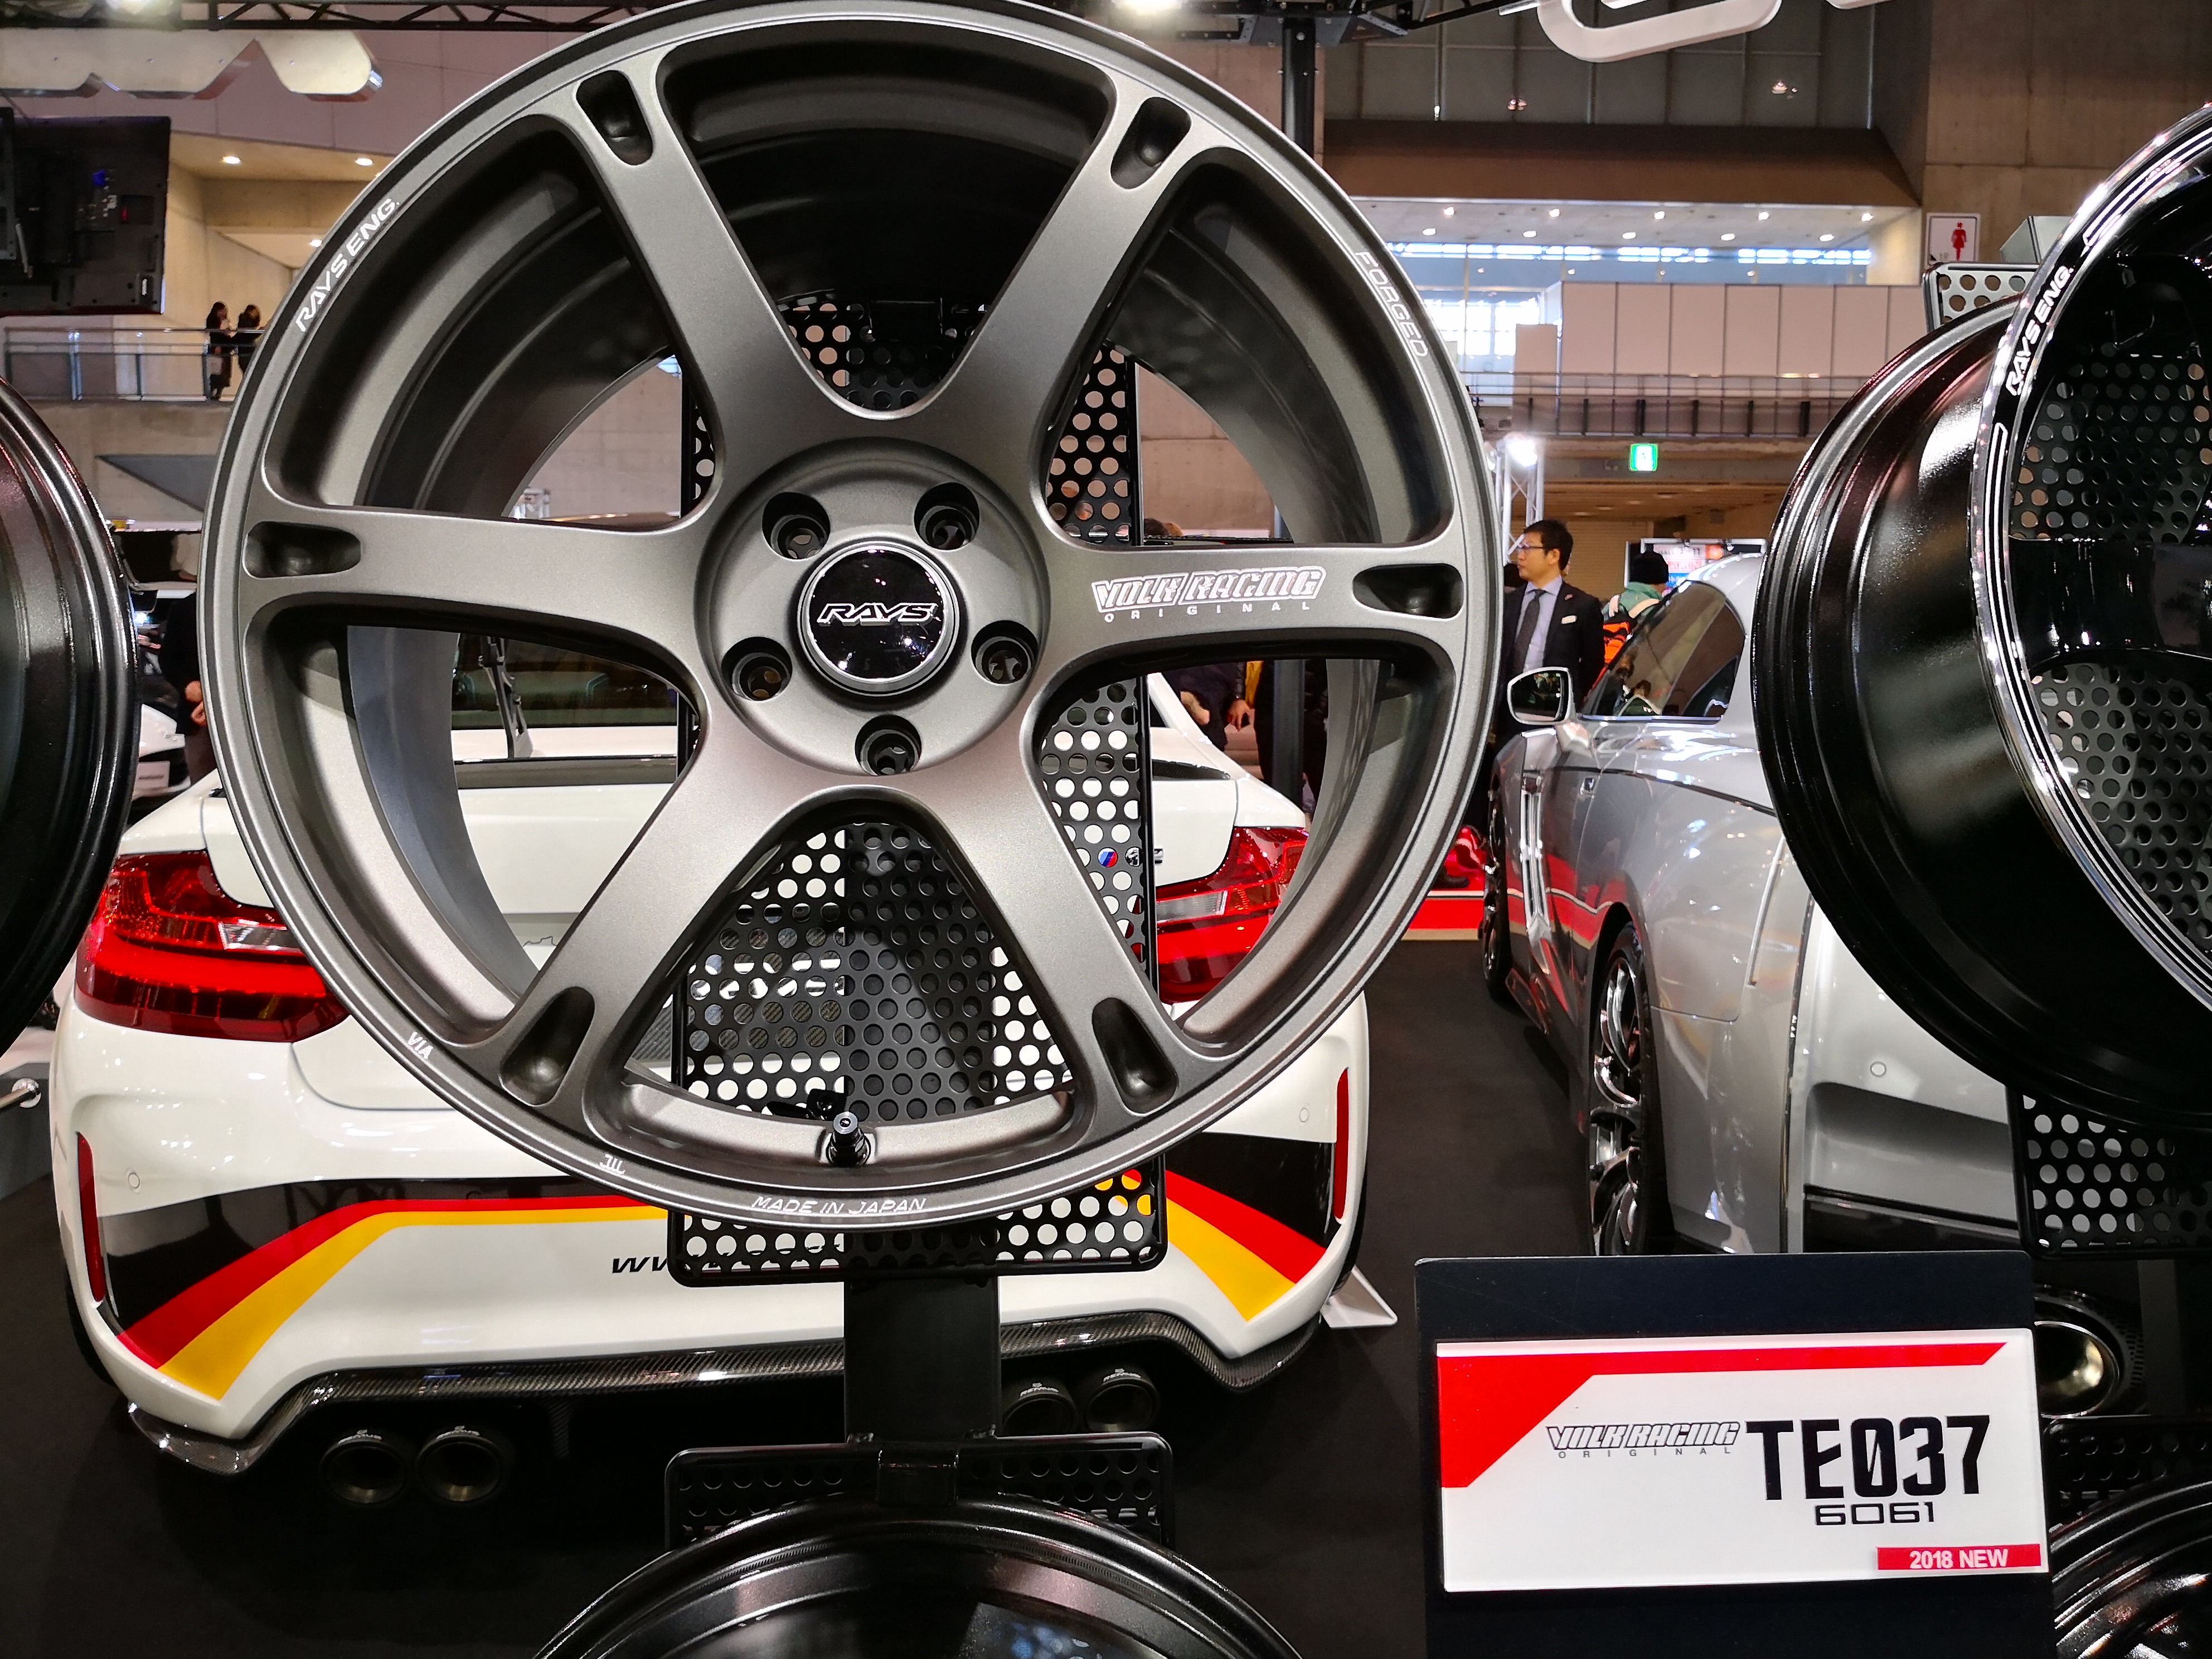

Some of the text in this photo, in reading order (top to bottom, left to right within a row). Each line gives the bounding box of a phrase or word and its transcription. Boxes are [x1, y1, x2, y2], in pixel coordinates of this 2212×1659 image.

[295, 198, 400, 332] RAYS ENG.
[1355, 251, 1428, 357] FORGED
[2006, 319, 2041, 396] RAYS
[1091, 565, 1326, 613] VOLK RACING
[817, 602, 939, 625] RAYS
[1104, 601, 1311, 623] ORIGINAL
[408, 1031, 434, 1059] VIA
[751, 1196, 927, 1214] MADE IN JAPAN
[1546, 1421, 1740, 1450] VOLK RACING
[1558, 1448, 1731, 1459] ORIGINAL
[1745, 1414, 1990, 1501] TE037
[1815, 1501, 1935, 1526] 6061
[1909, 1549, 2009, 1570] 2018 NEW
